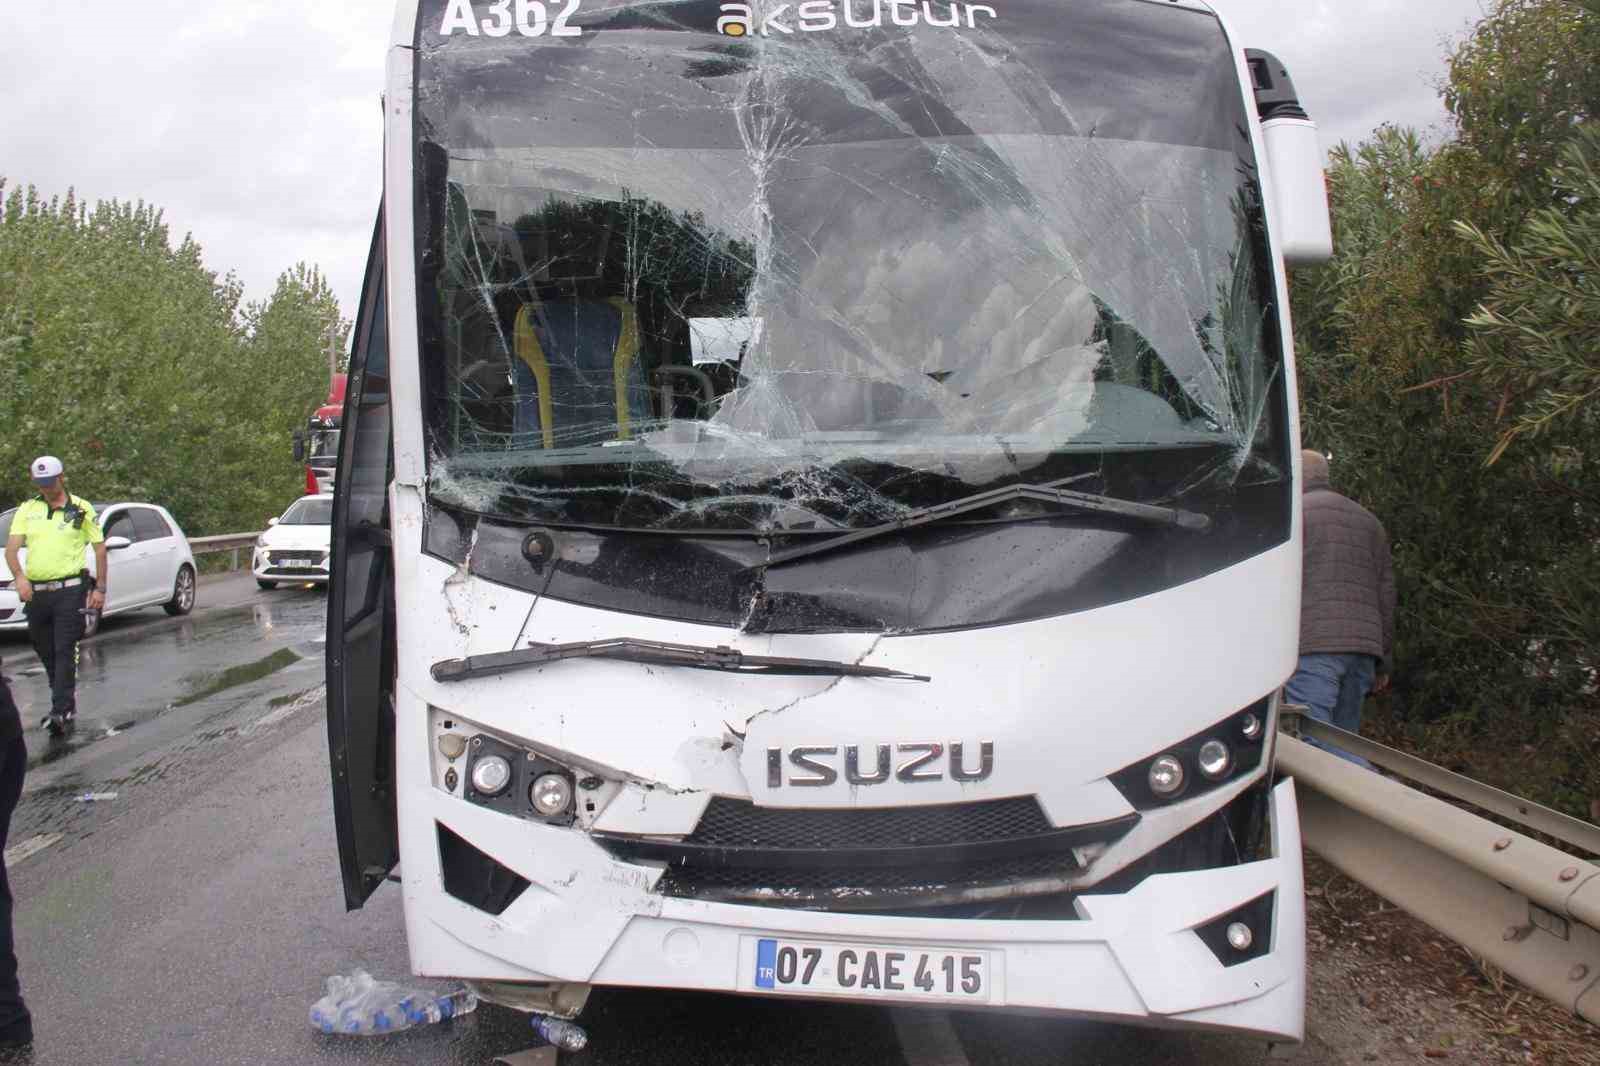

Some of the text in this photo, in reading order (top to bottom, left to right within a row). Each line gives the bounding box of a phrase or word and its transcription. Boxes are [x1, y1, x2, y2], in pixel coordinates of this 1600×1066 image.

[440, 0, 582, 37] A362
[767, 740, 994, 788] ISUZU
[759, 967, 774, 979] TR
[776, 946, 982, 994] 07 CAE 415
